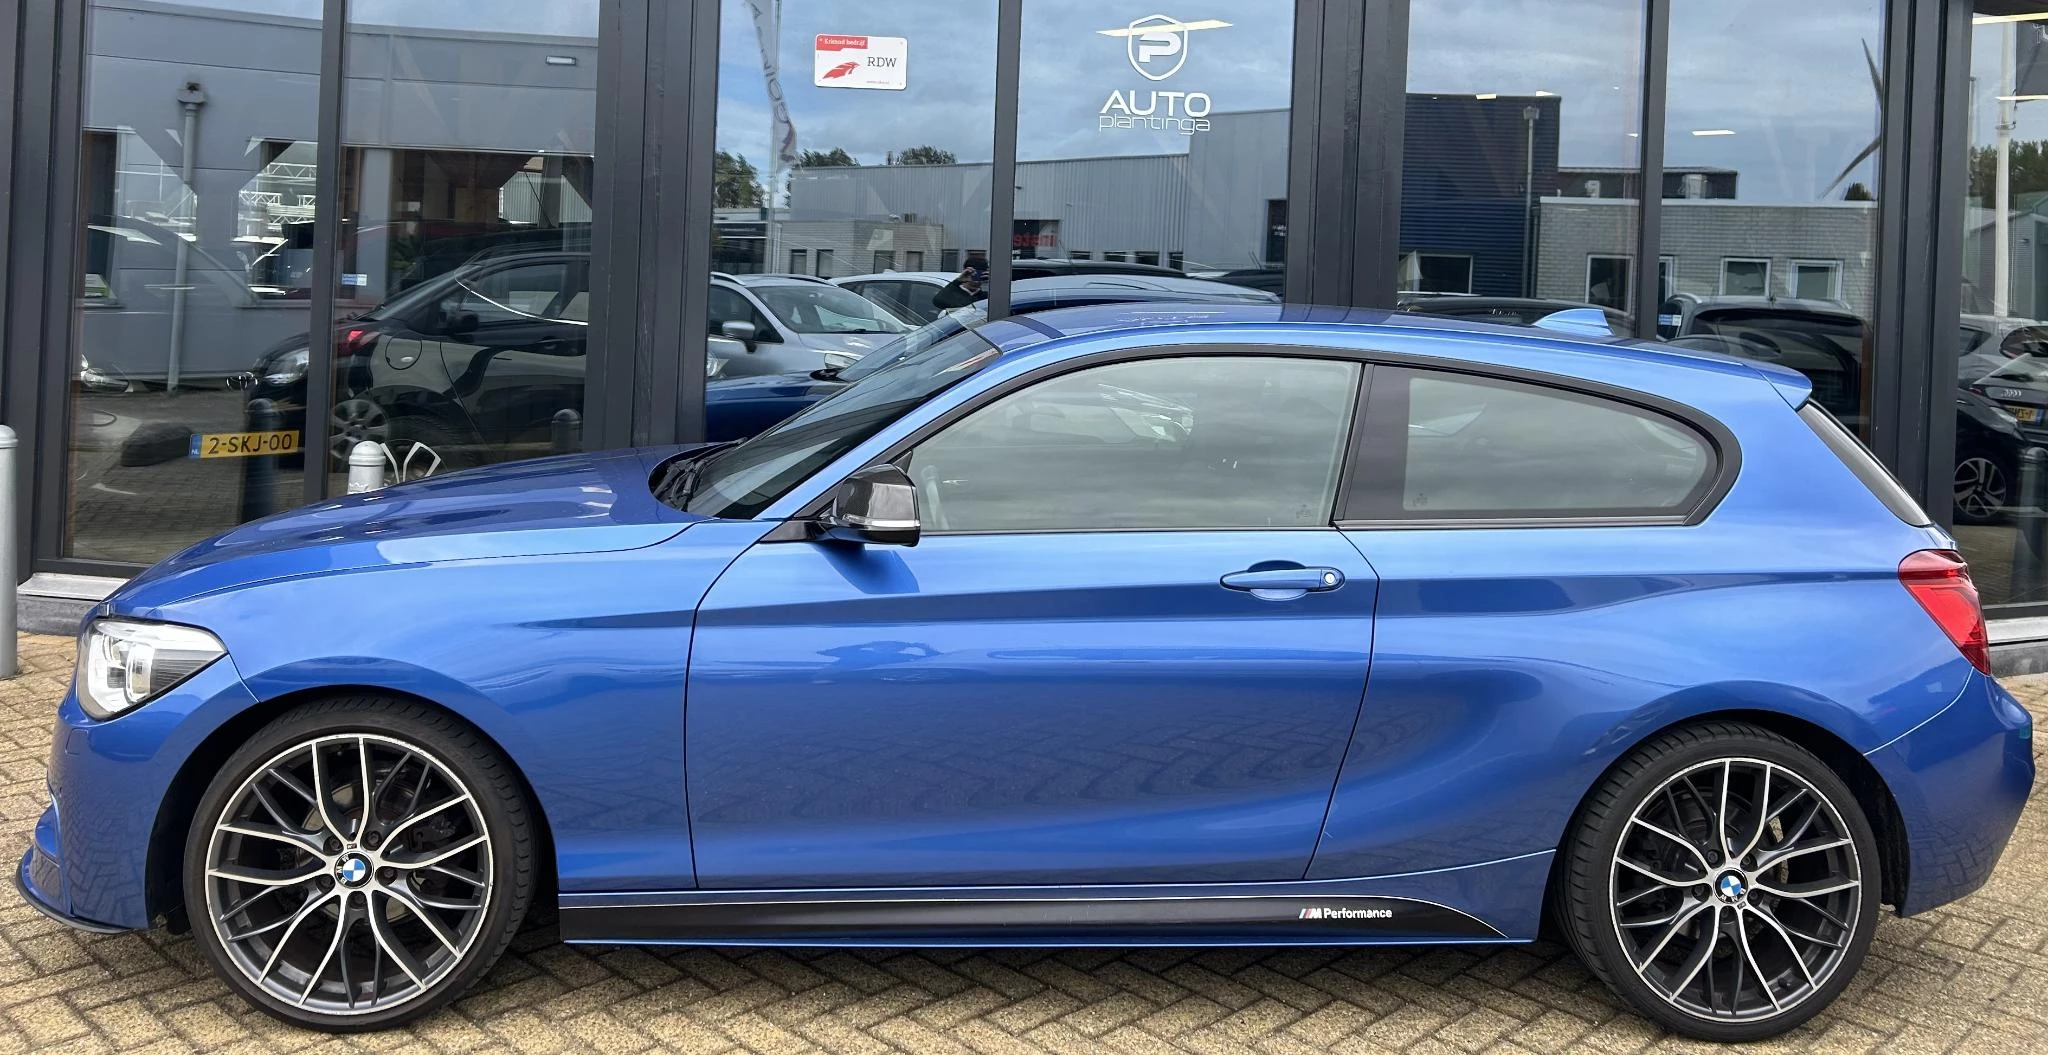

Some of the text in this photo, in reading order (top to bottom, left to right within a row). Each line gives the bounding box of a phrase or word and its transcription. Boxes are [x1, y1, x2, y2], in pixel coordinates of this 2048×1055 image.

[867, 57, 896, 68] RDW
[1099, 90, 1211, 117] AUTO
[1099, 114, 1210, 135] plantinga
[208, 434, 292, 454] 2-SKJ-00
[1323, 907, 1393, 919] Performance
